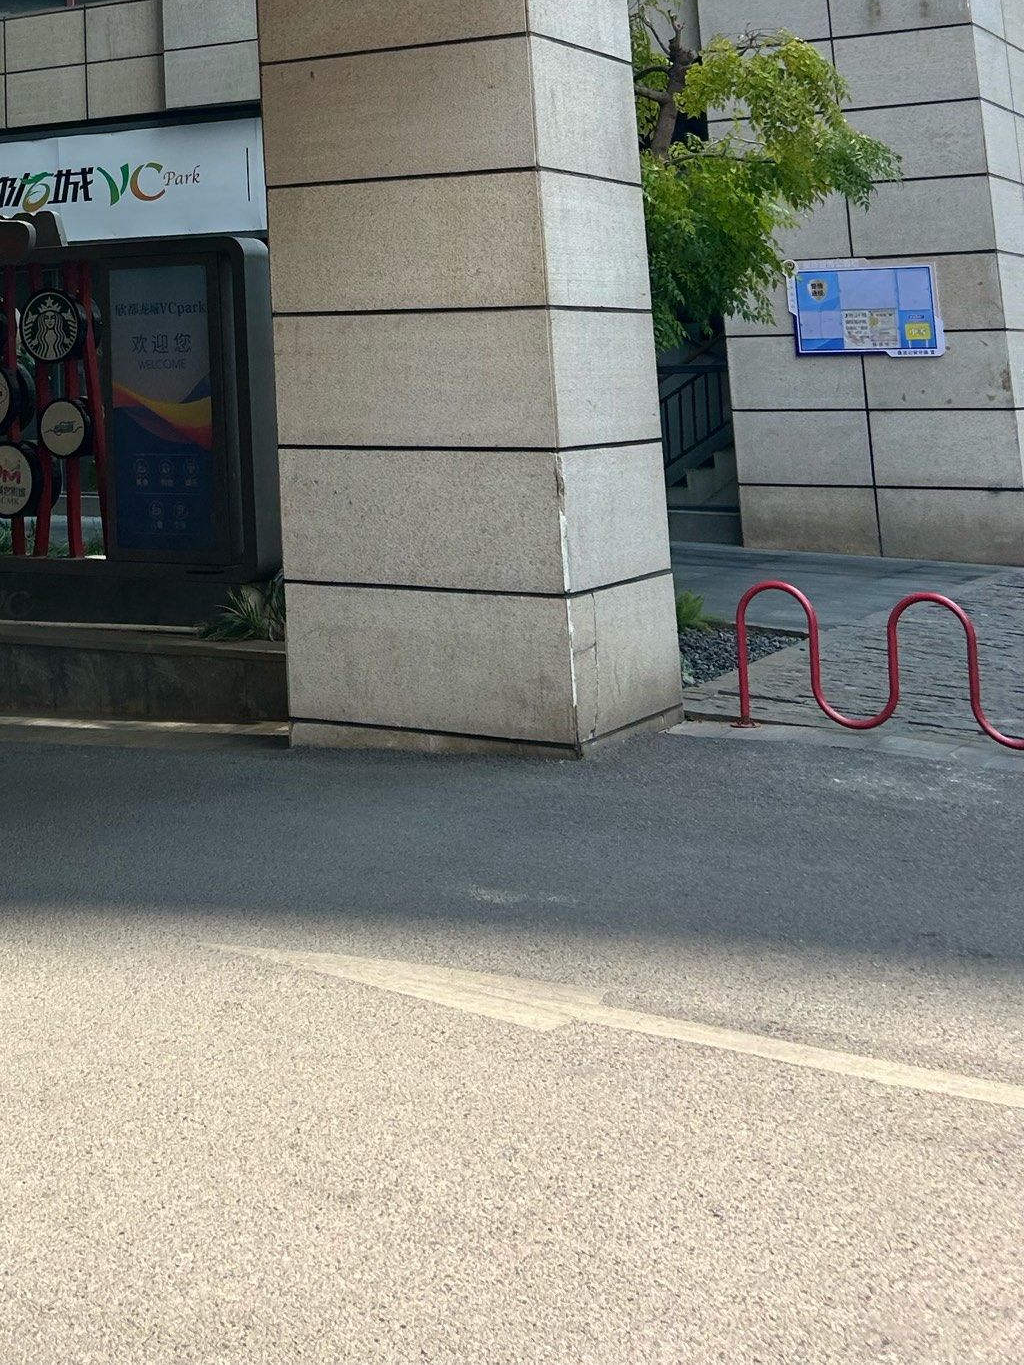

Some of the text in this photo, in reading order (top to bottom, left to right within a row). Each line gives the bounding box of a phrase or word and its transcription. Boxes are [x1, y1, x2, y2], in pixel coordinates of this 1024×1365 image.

[163, 164, 201, 187] Park
[131, 332, 192, 354] 欢迎您
[137, 358, 187, 371] WELCOME
